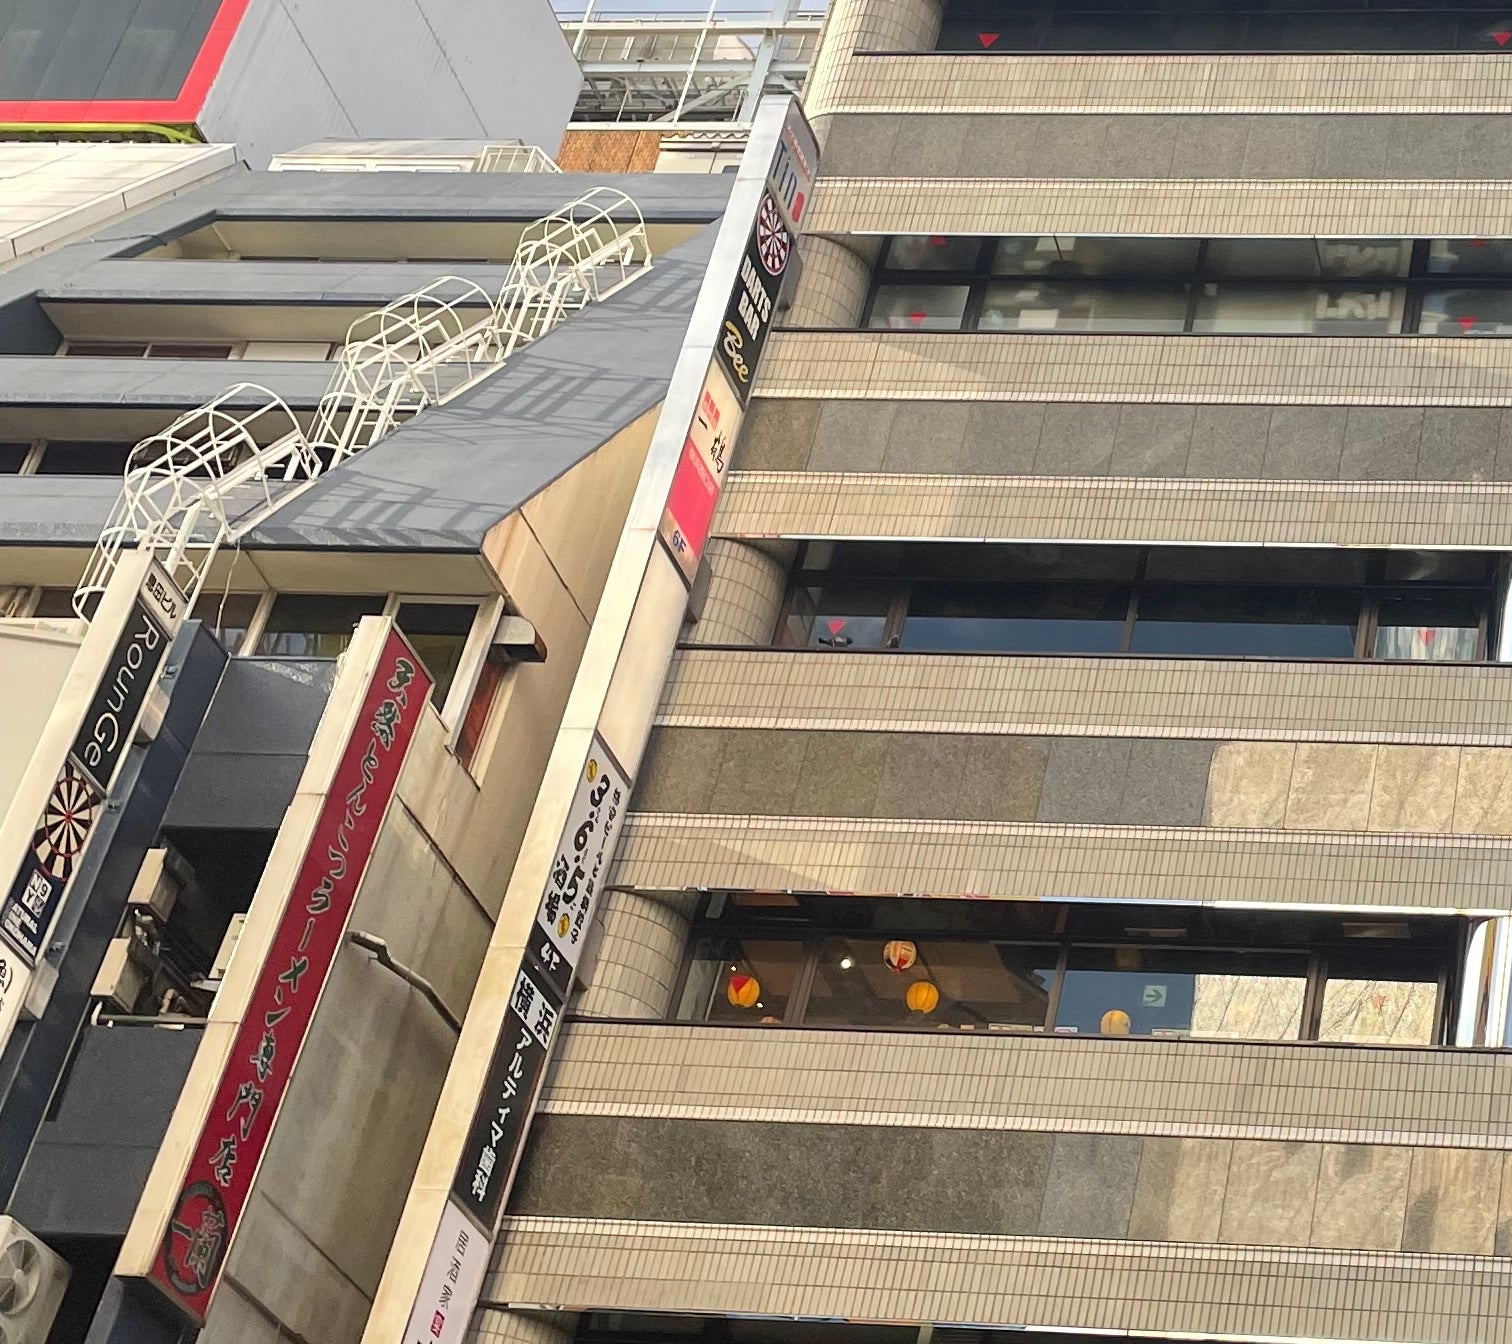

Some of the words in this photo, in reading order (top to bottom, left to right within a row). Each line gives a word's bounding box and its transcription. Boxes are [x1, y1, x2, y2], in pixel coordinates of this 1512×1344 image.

[738, 291, 760, 341] BAR
[741, 254, 771, 323] DARTS
[724, 320, 749, 383] Bee
[672, 530, 687, 553] 6F
[539, 941, 561, 972] 4F
[471, 1026, 533, 1203] アルティマ歯科
